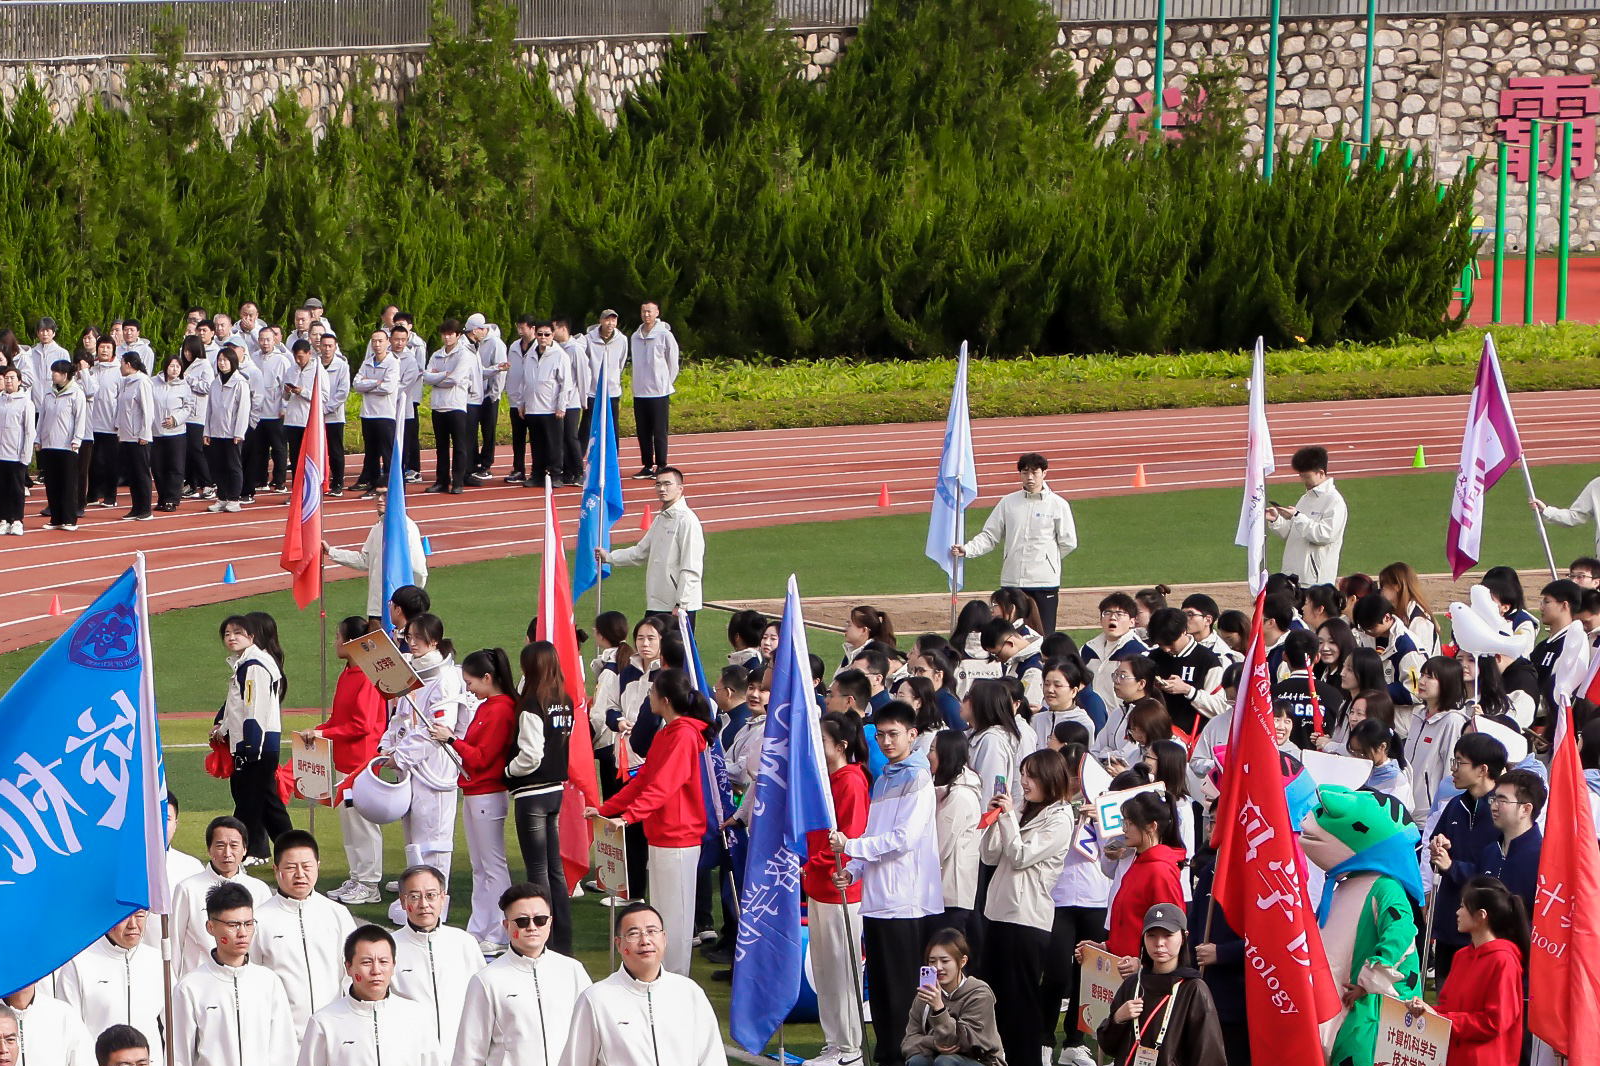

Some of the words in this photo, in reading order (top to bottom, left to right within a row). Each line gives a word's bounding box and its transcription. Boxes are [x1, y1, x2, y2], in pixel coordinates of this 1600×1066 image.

[1541, 651, 1555, 667] H
[1181, 666, 1196, 682] H
[1294, 703, 1326, 717] CAS
[1387, 1026, 1437, 1061] 计算机科学与
